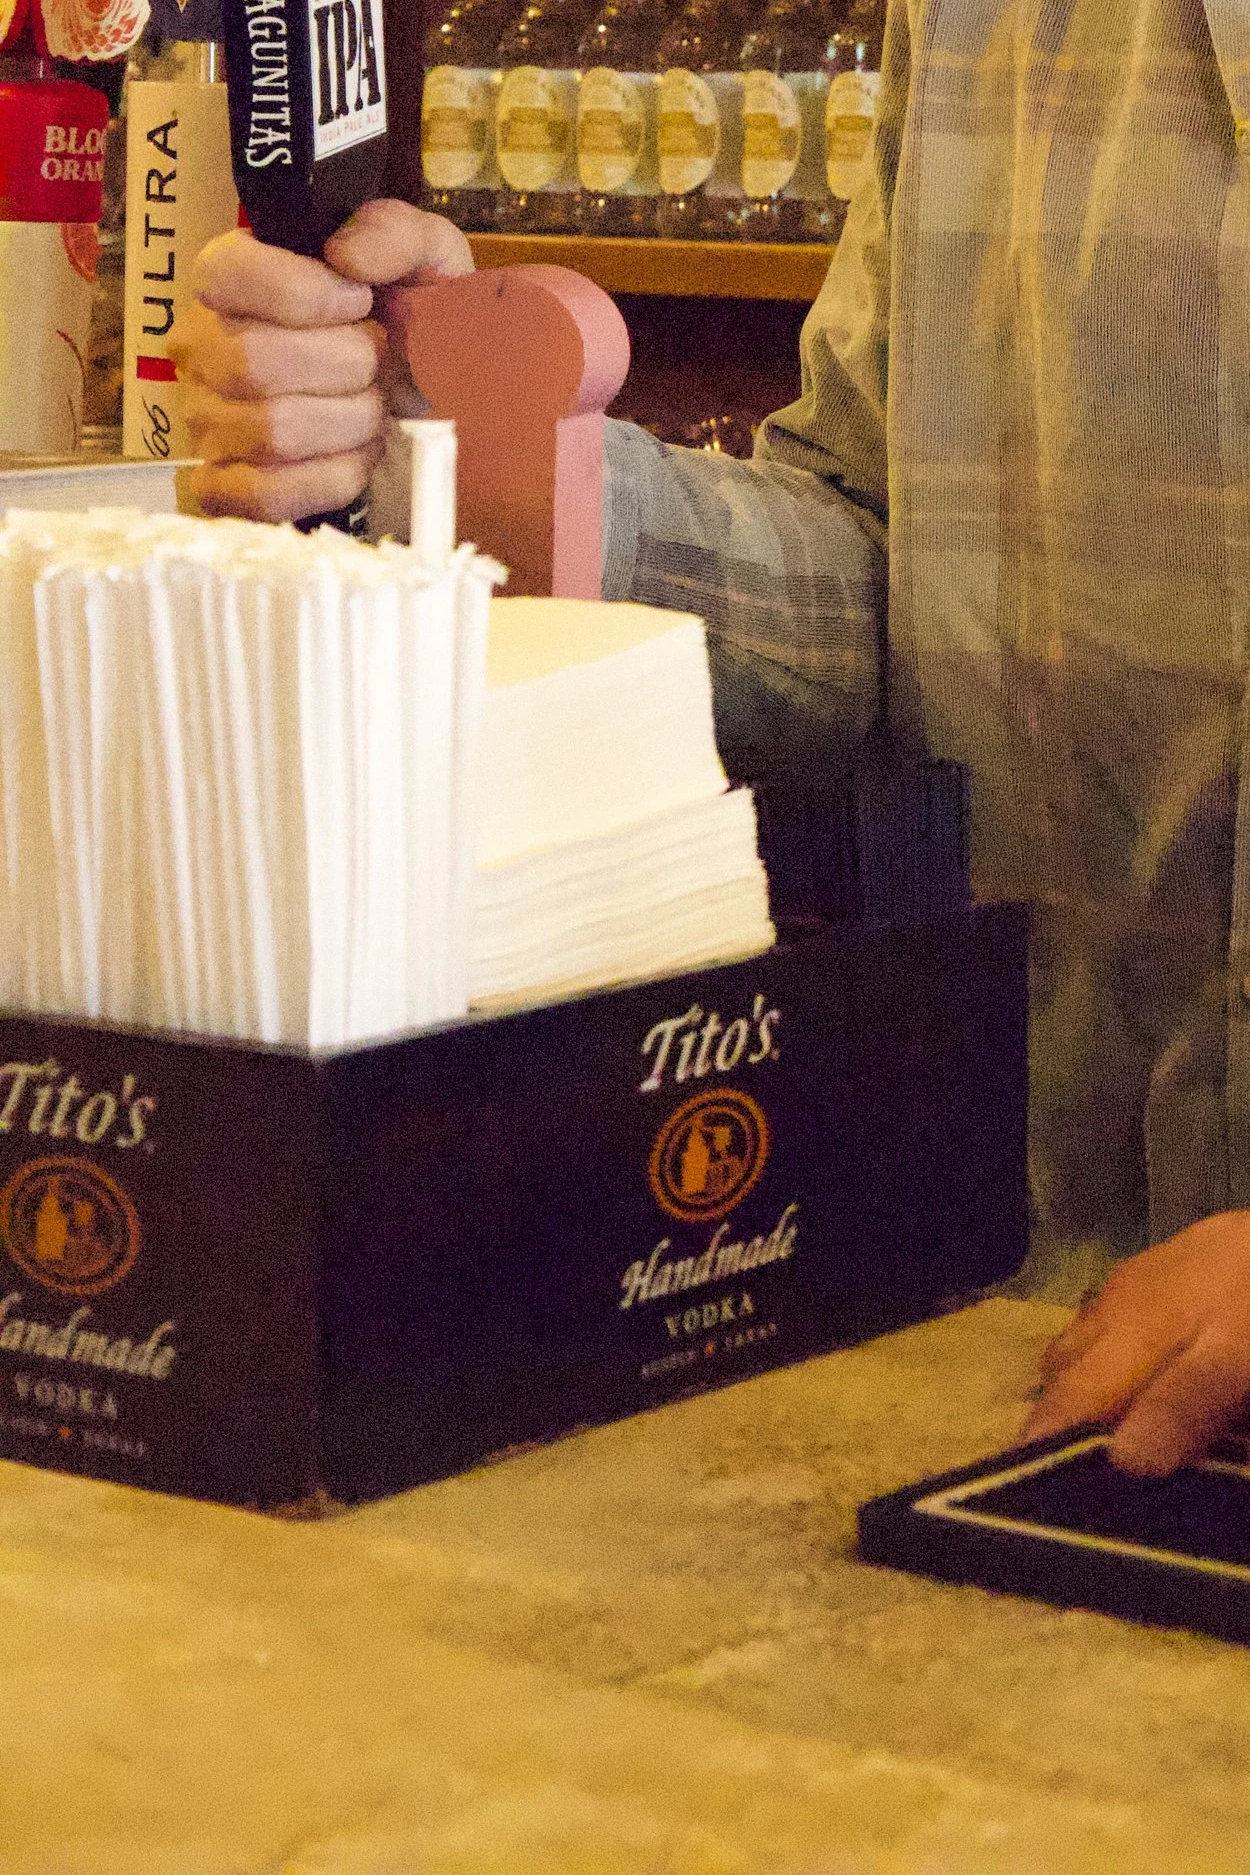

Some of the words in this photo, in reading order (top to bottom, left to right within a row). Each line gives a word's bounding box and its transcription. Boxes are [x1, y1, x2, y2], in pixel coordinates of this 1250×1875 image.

[40, 157, 102, 182] ORAN
[44, 126, 105, 154] BLO
[142, 118, 179, 337] ULTRA
[638, 992, 782, 1093] Tito's
[0, 1057, 158, 1149] Tito's
[619, 1202, 799, 1309] Handmade
[664, 1291, 755, 1338] VODKA
[14, 1372, 119, 1420] VODKA
